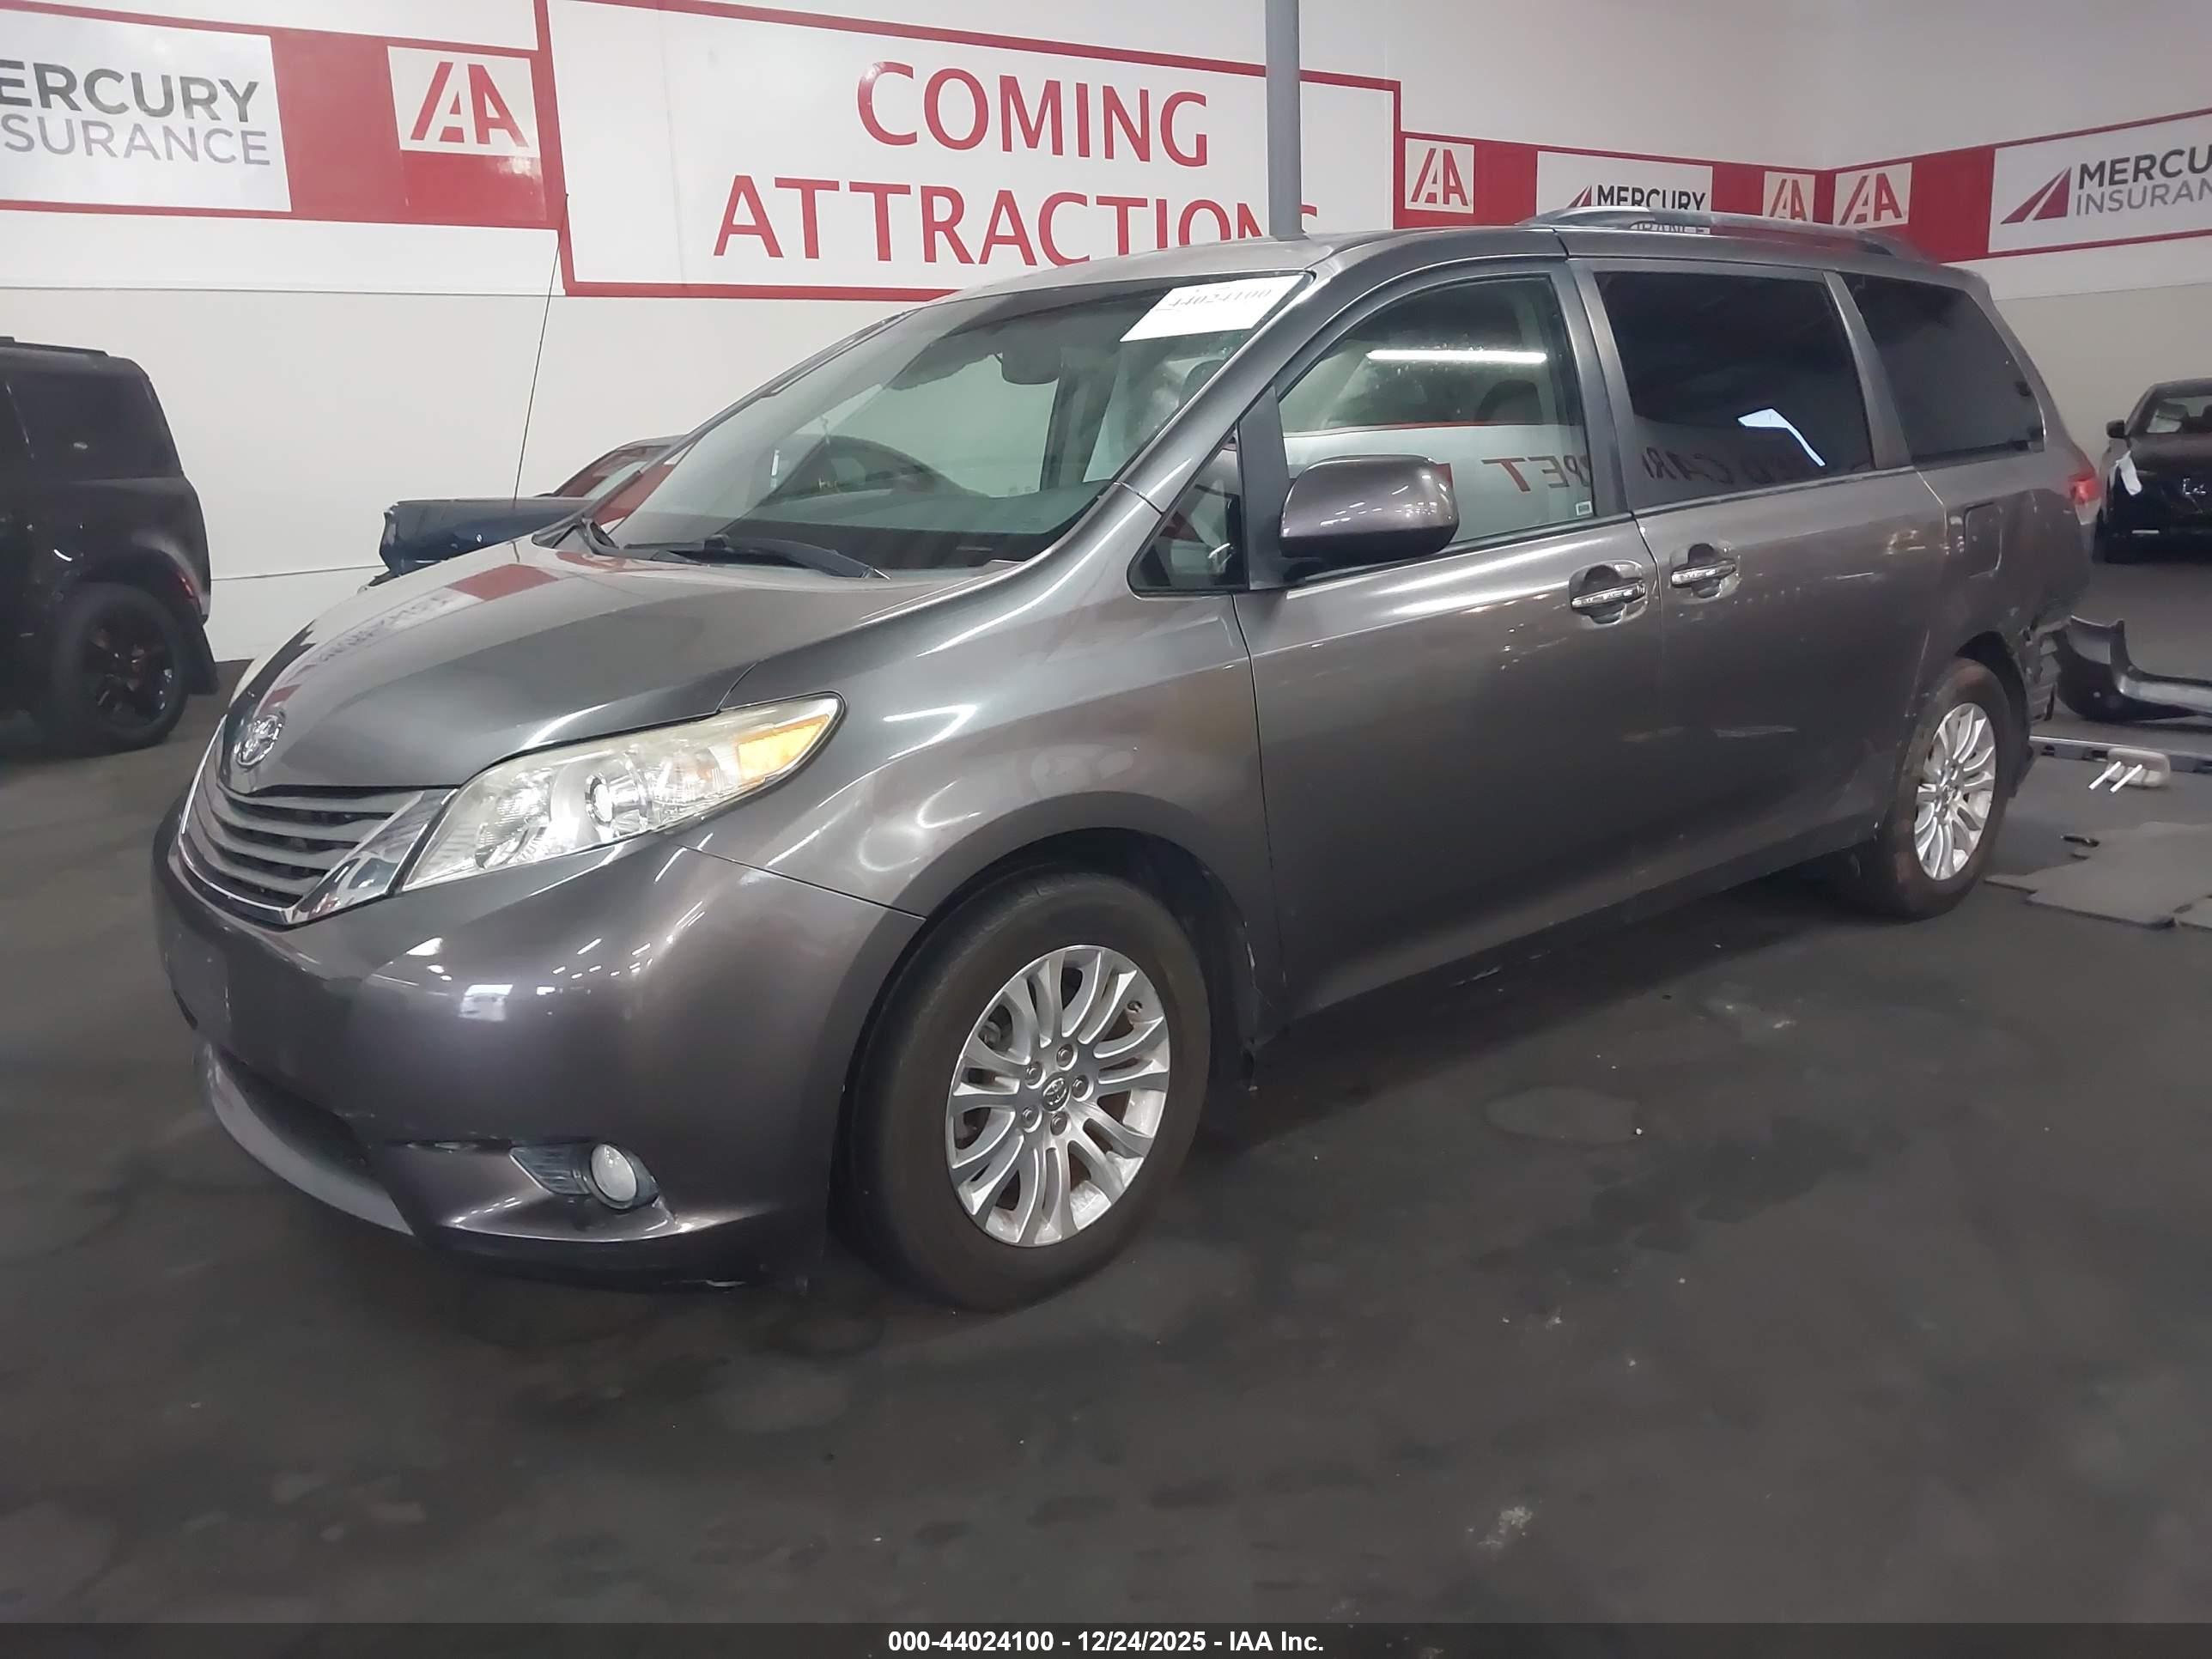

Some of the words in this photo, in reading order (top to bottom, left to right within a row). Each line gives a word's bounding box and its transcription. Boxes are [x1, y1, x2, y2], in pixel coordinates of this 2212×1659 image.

[1, 113, 270, 166] SURANCE
[857, 62, 1207, 167] COMING
[2078, 144, 2212, 190] MERCU
[714, 174, 1317, 266] ATTRACTIO
[1597, 185, 1706, 210] MERCURY
